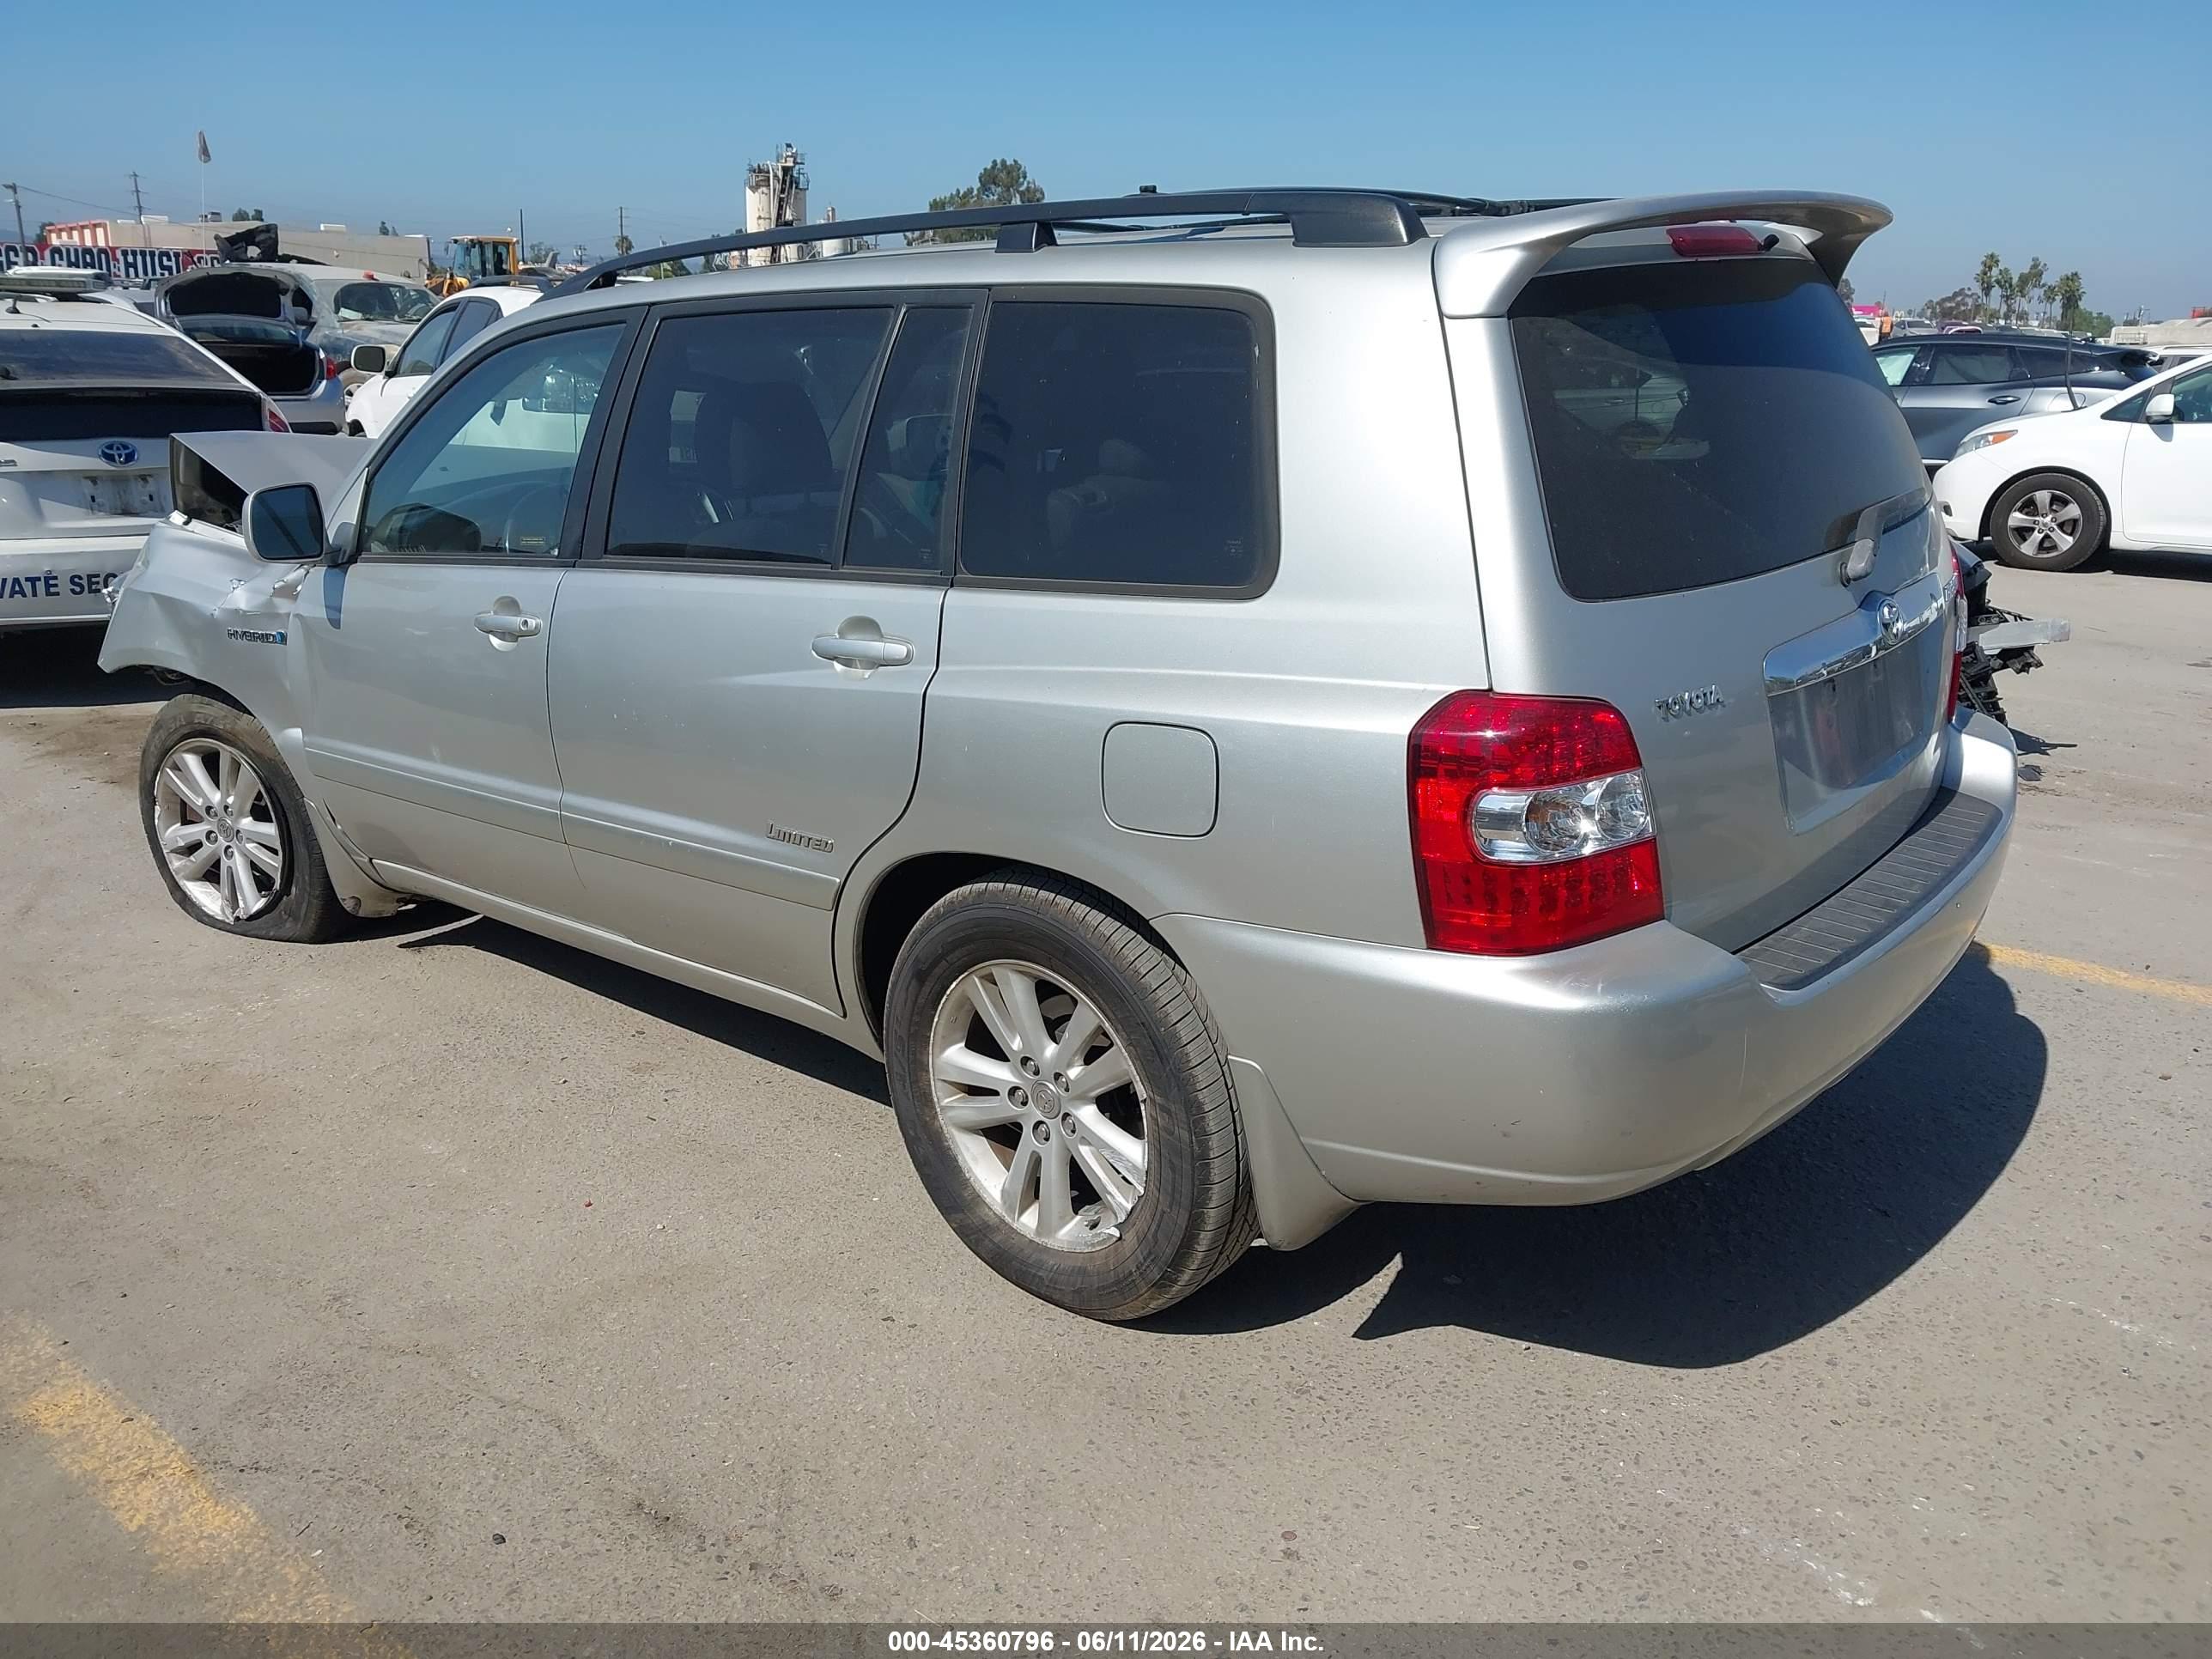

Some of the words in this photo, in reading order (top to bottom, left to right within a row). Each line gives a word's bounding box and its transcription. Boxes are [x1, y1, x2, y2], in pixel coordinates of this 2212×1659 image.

[69, 572, 124, 596] SEC
[227, 628, 276, 643] HYBRID
[1654, 684, 1724, 721] TOYOTA
[767, 823, 835, 853] LIMITED
